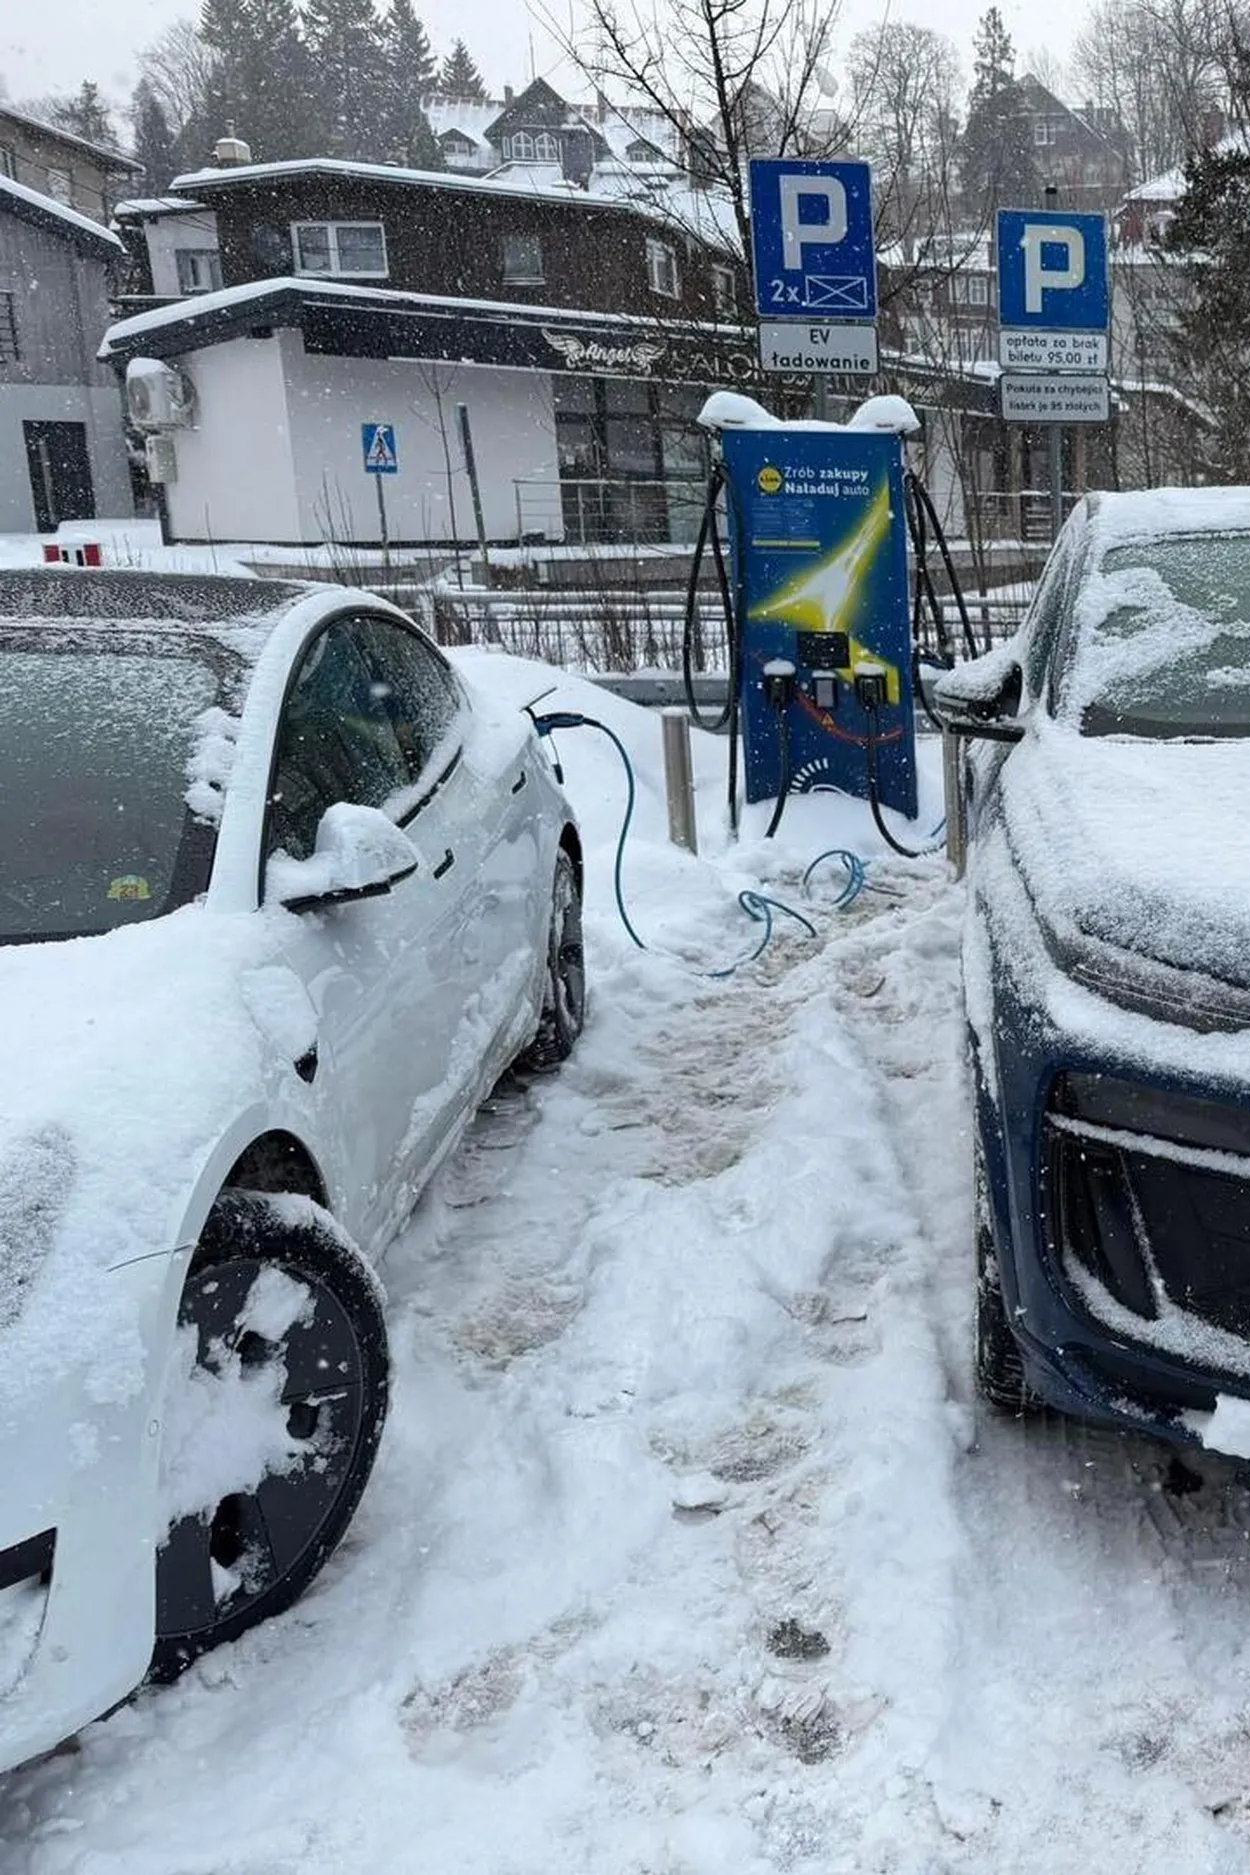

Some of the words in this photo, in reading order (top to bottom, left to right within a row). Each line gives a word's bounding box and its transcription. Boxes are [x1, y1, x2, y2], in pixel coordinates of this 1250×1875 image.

[779, 174, 848, 270] P
[1023, 223, 1085, 313] P
[770, 279, 801, 303] 2x
[809, 328, 831, 345] EV
[1072, 337, 1099, 349] brak
[771, 351, 871, 371] ładowanie
[1007, 350, 1043, 363] biletu
[1047, 351, 1082, 364] 95.00
[784, 466, 815, 479] Zrób
[819, 467, 869, 482] zakupy
[842, 485, 870, 497] auto
